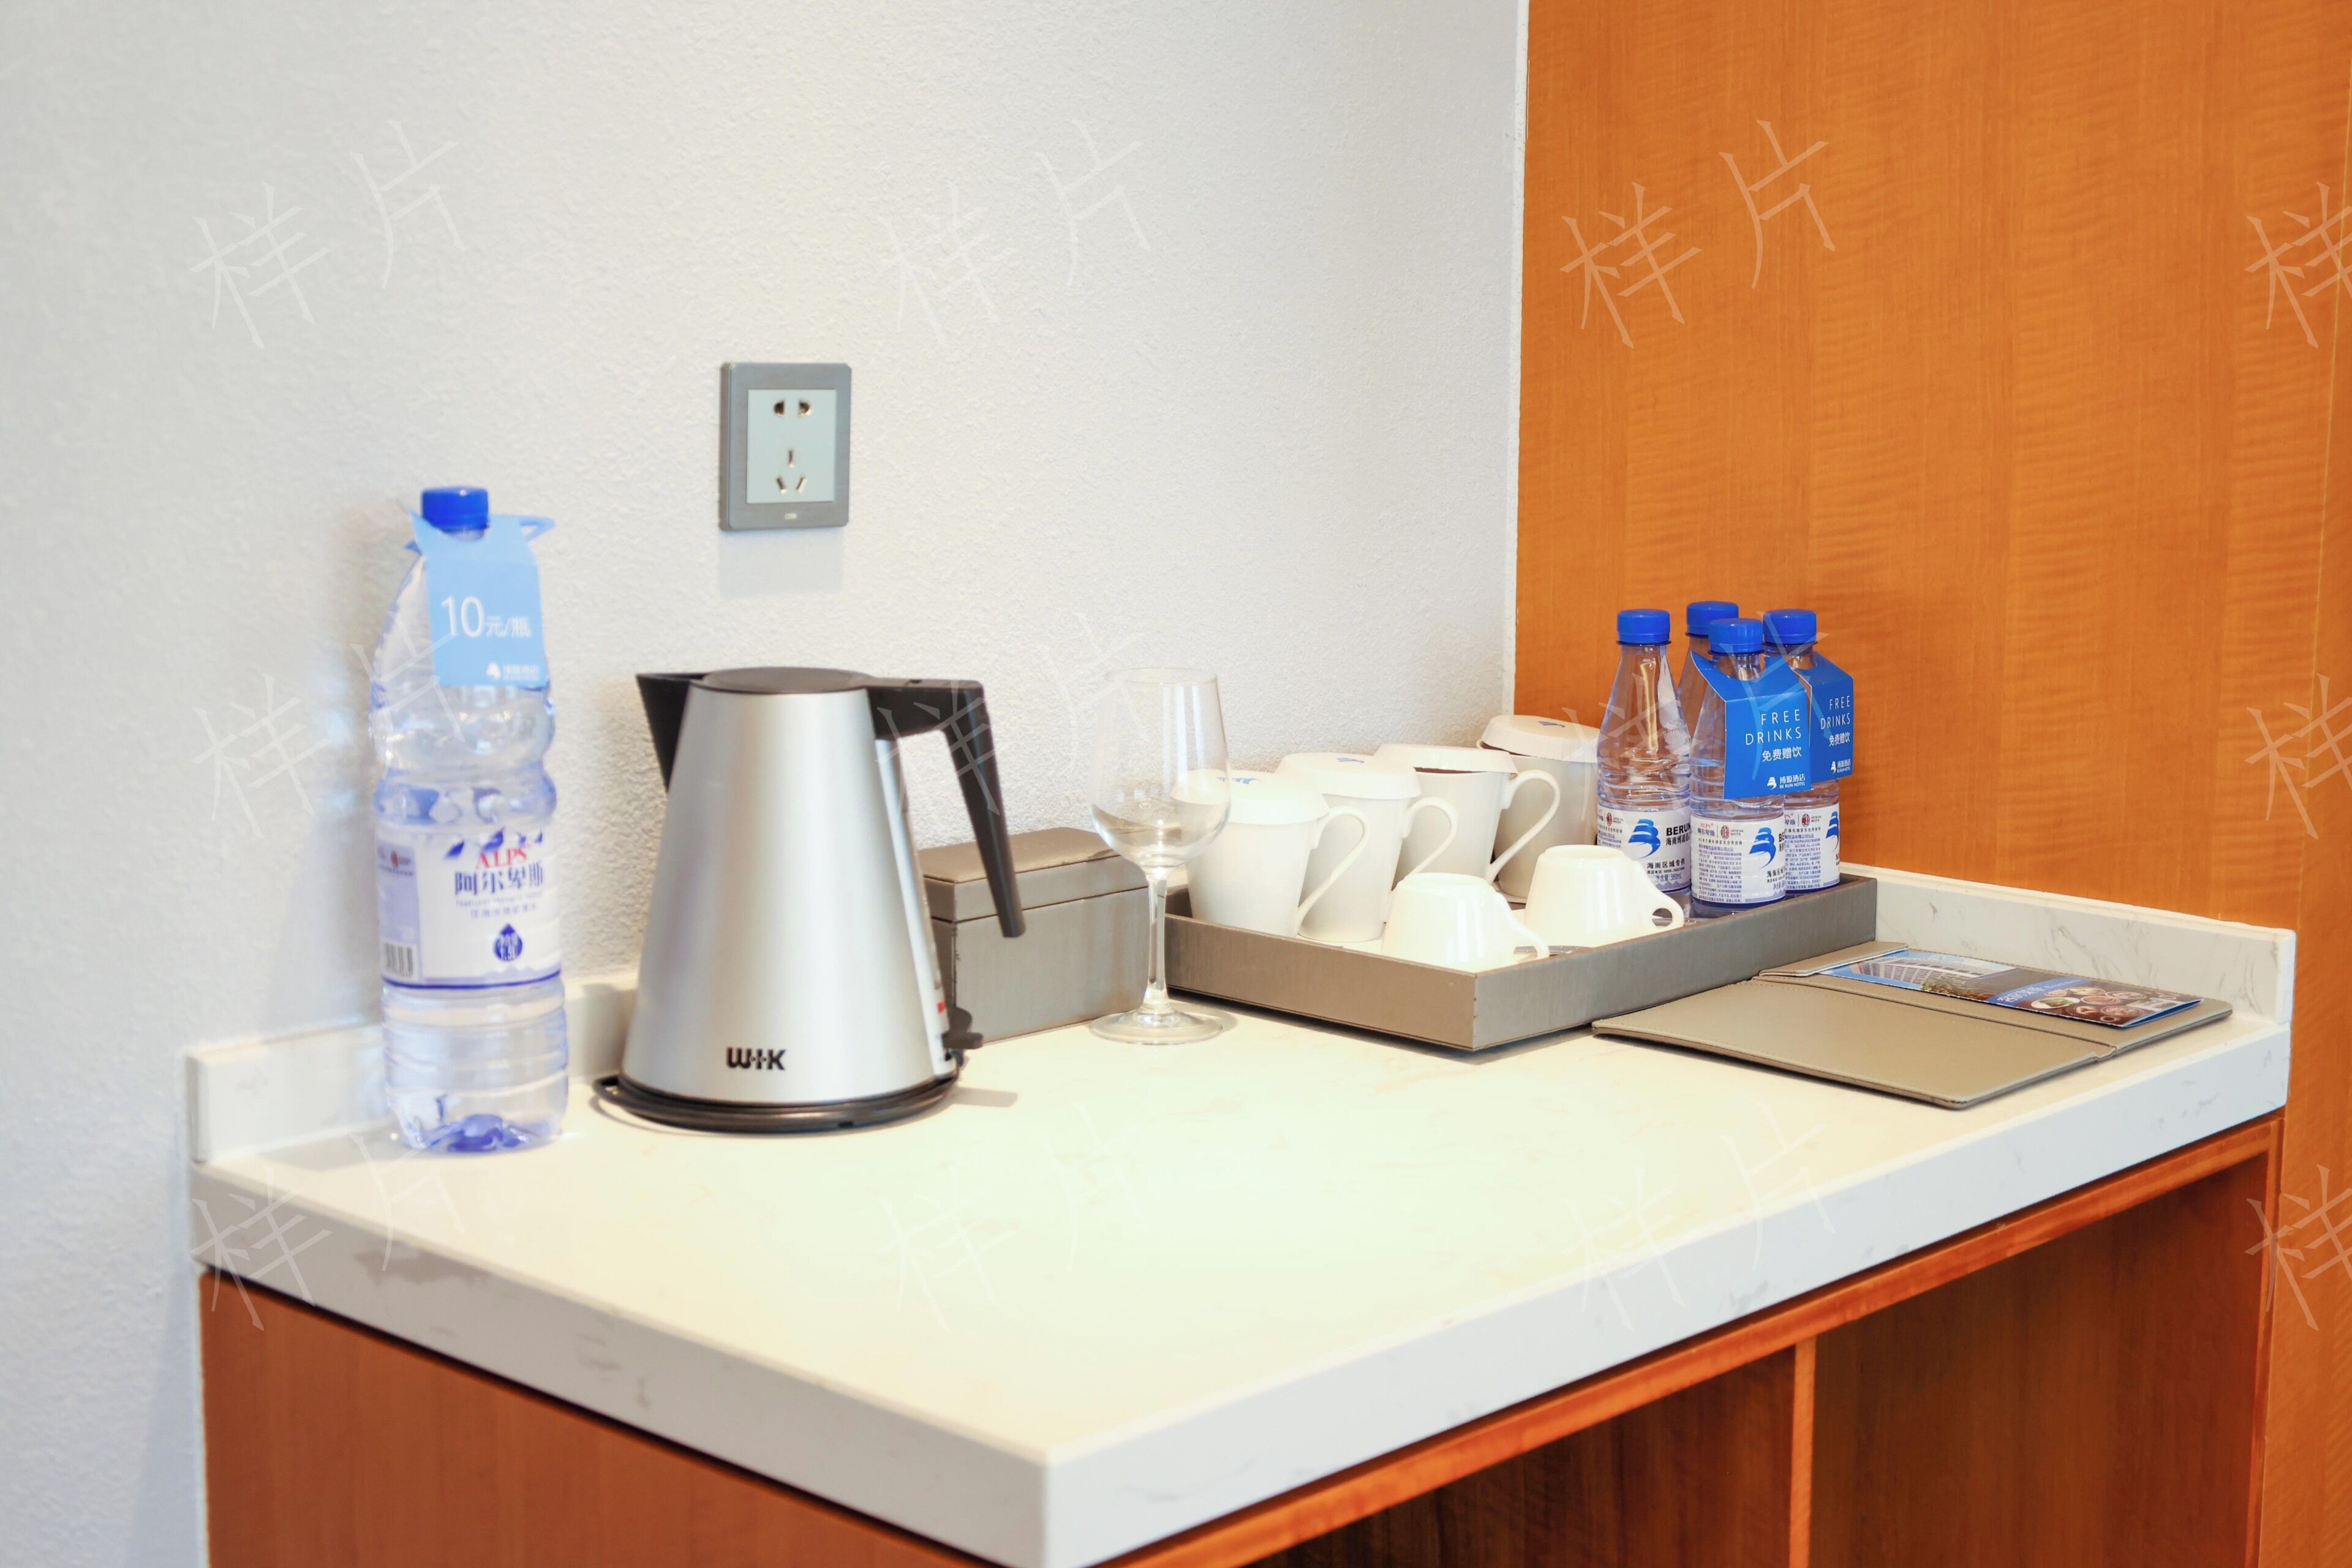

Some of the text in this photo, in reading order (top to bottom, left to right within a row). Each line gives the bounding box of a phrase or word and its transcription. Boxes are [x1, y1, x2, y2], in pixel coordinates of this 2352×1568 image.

[1830, 695, 1850, 710] FREE
[1760, 709, 1801, 726] FREE
[1820, 712, 1850, 730] DRINKS
[1745, 726, 1802, 745] DRINKS
[1829, 731, 1850, 747] 免费赠饮
[1762, 745, 1803, 763] 免费赠饮
[476, 846, 527, 870] ALPS
[454, 860, 543, 896] 阿尔卑斯
